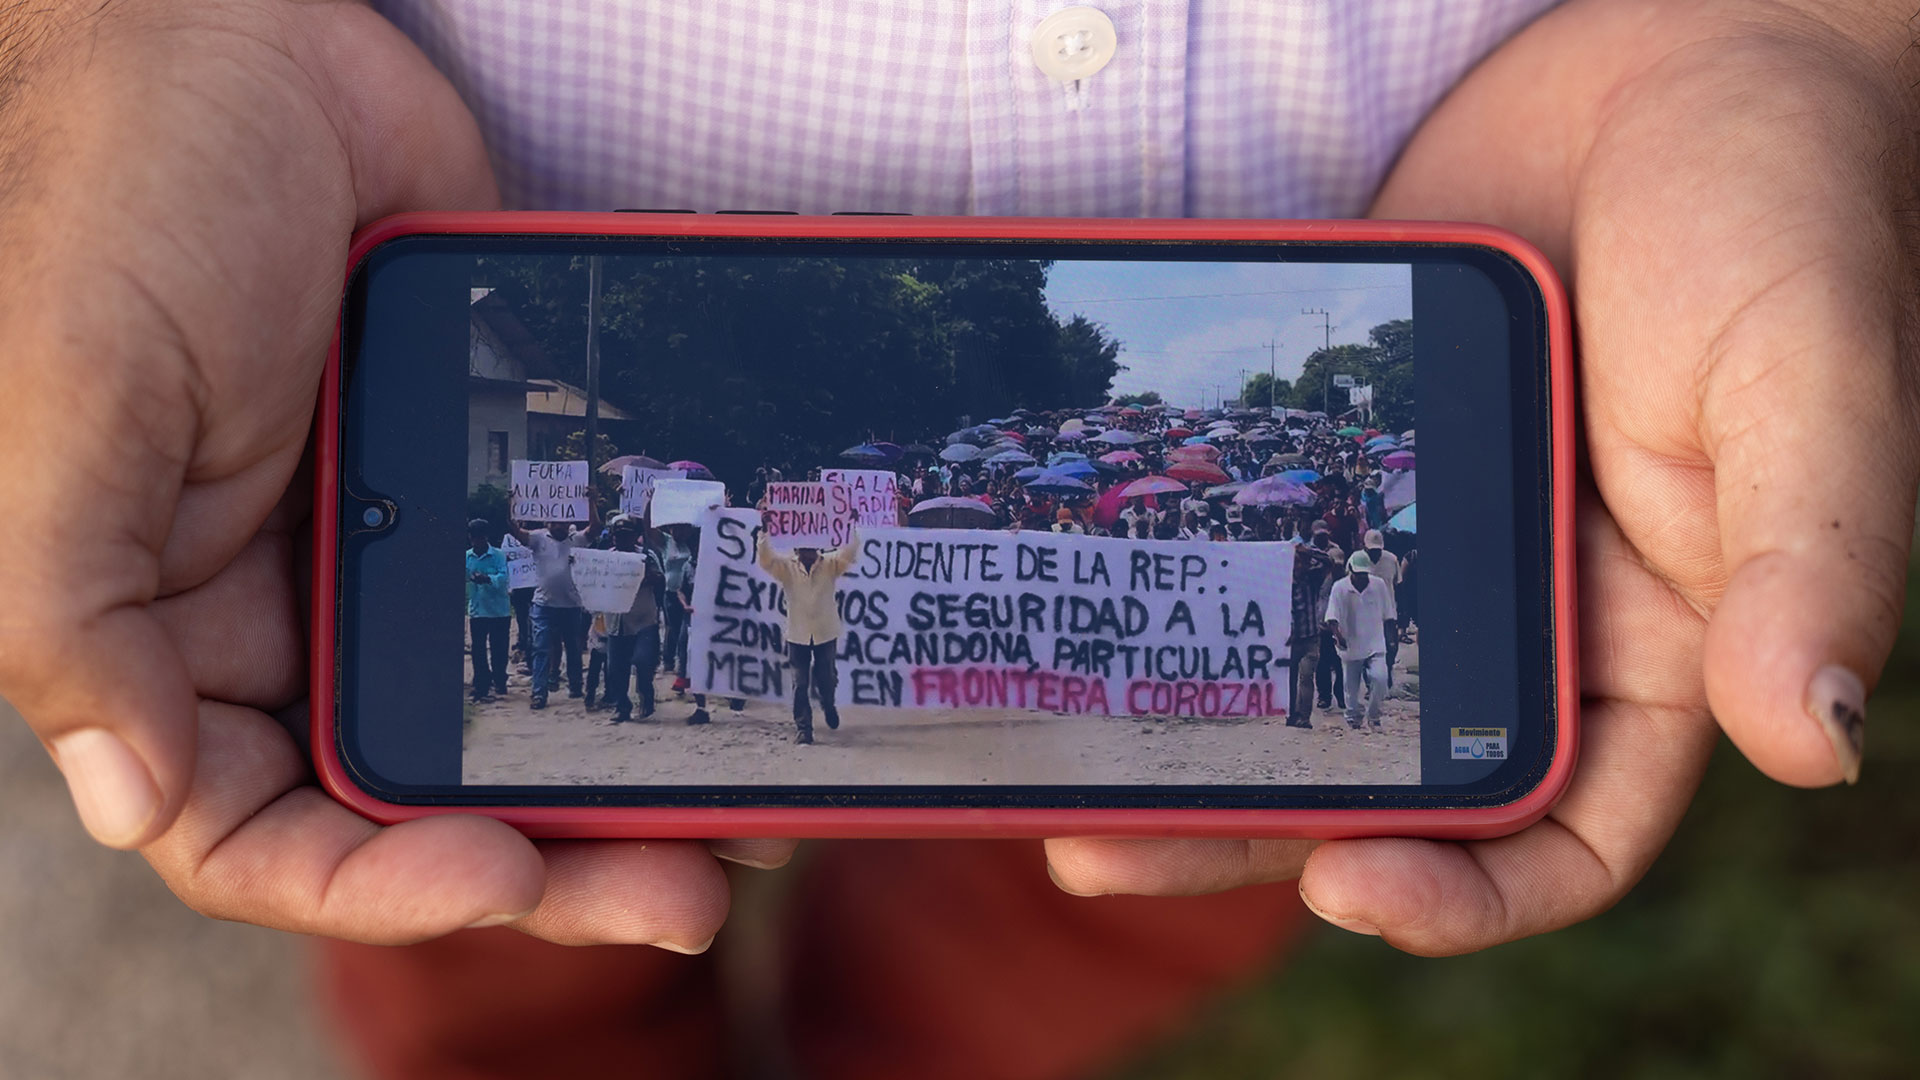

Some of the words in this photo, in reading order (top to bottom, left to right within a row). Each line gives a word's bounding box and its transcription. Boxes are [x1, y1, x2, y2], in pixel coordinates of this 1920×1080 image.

[528, 463, 573, 480] FUERA
[855, 475, 865, 492] A
[873, 475, 896, 494] LA
[769, 485, 825, 507] MARINA
[858, 496, 897, 513] RDIA
[513, 503, 576, 518] CUENCIA
[766, 510, 828, 537] SEDENA
[843, 539, 1003, 583] SIDENTE
[1016, 543, 1059, 582] DE
[1074, 550, 1111, 587] LA
[906, 591, 1150, 639] SEGURIDAD
[1165, 600, 1196, 635] A
[1221, 600, 1265, 637] LA
[710, 615, 788, 655] ZON
[1053, 636, 1291, 682] PARTICULAR-
[850, 669, 903, 707] EN
[911, 667, 1110, 715] FRONTERA
[1128, 680, 1287, 717] COROZAL
[1458, 728, 1501, 737] Movimiento
[1454, 746, 1470, 754] AGUA
[1485, 742, 1500, 750] PARA
[1486, 750, 1504, 758] TODOS
